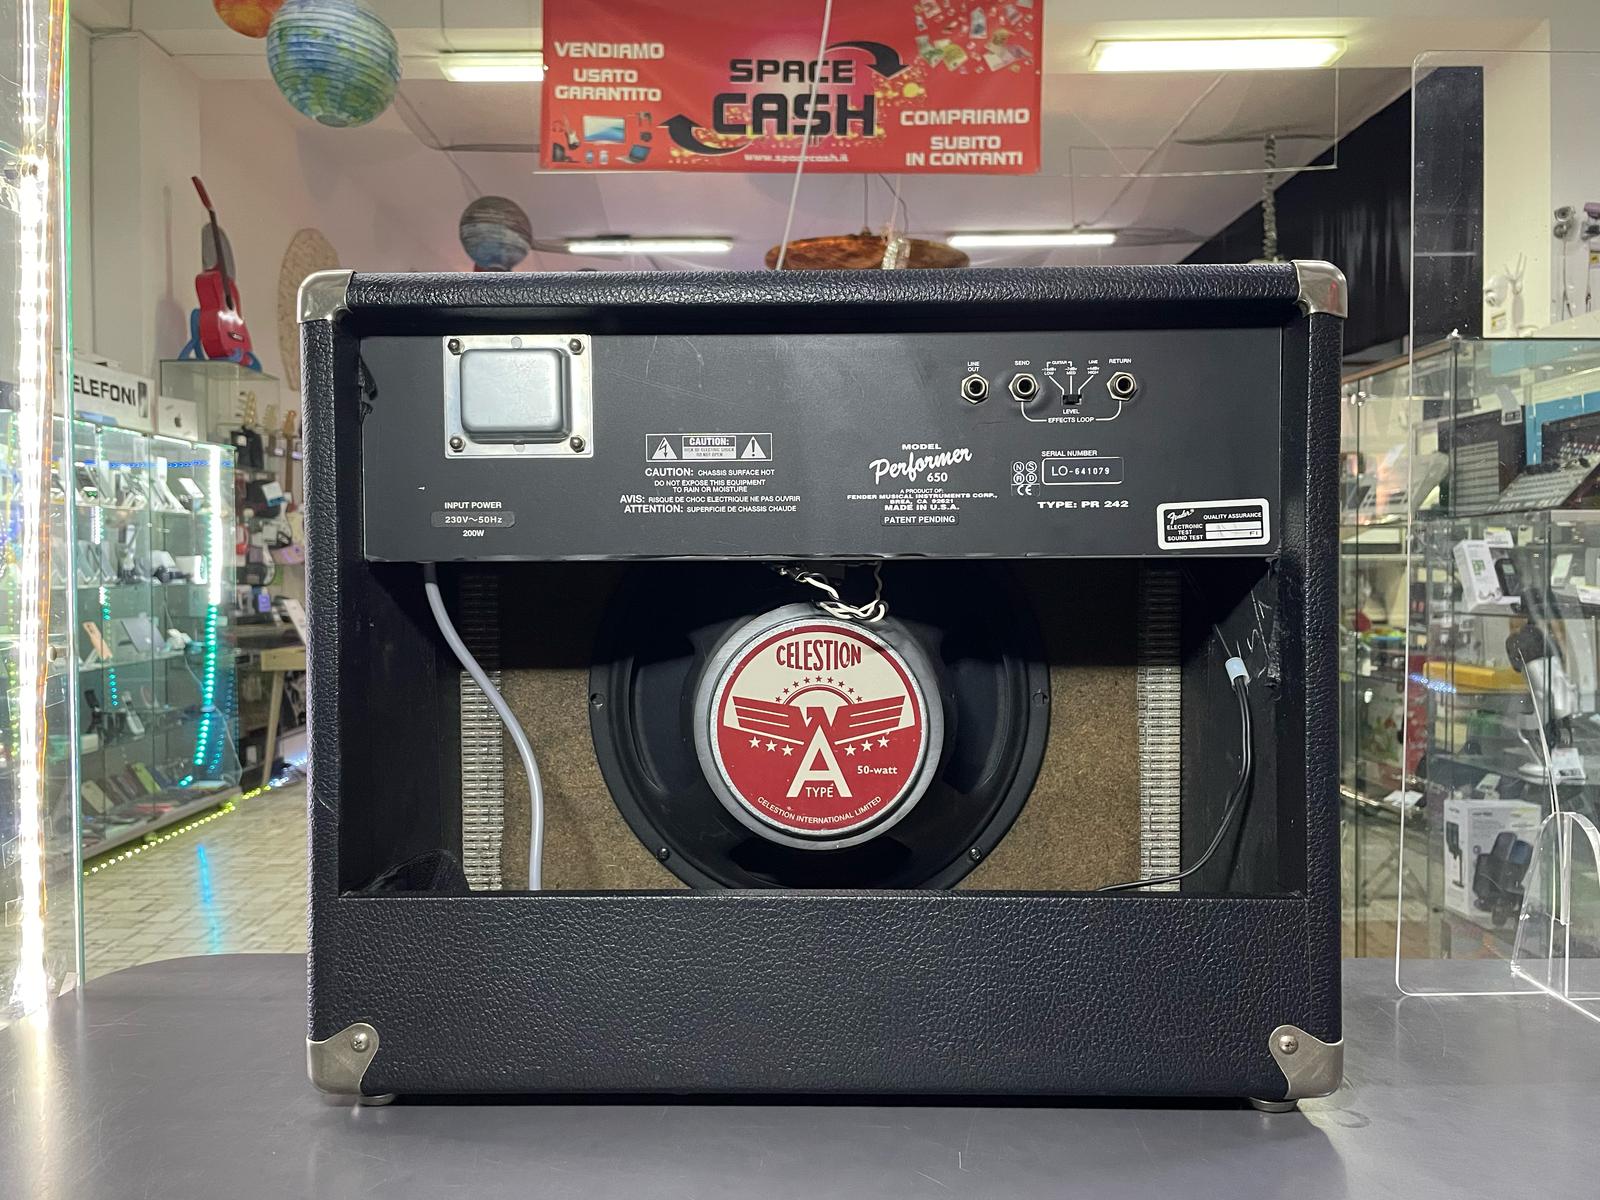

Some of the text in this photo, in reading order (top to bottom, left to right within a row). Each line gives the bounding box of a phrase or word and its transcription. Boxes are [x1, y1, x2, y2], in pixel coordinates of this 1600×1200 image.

[554, 42, 665, 60] VENDIAMO
[573, 68, 638, 84] USATO
[730, 58, 853, 84] SPACE
[554, 85, 662, 102] GARANTITO
[900, 108, 1030, 126] COMPRIAMO
[930, 136, 1001, 150] SUBITO
[906, 152, 1023, 166] IN CONTANTI
[74, 374, 136, 406] ELEFONI
[690, 437, 730, 446] CAUTION:
[645, 468, 694, 476] CAUTION:
[869, 447, 973, 485] Performer
[1052, 466, 1110, 476] LO-641079
[926, 473, 948, 482] 650
[620, 495, 645, 503] AVIS:
[624, 505, 683, 513] ATTENTION:
[776, 639, 862, 671] CELESTION
[786, 725, 853, 798] A
[857, 766, 898, 775] 50-watt
[805, 786, 834, 798] TYPE
[757, 796, 881, 824] CELESTION INTERNATIONAL LIMITED
